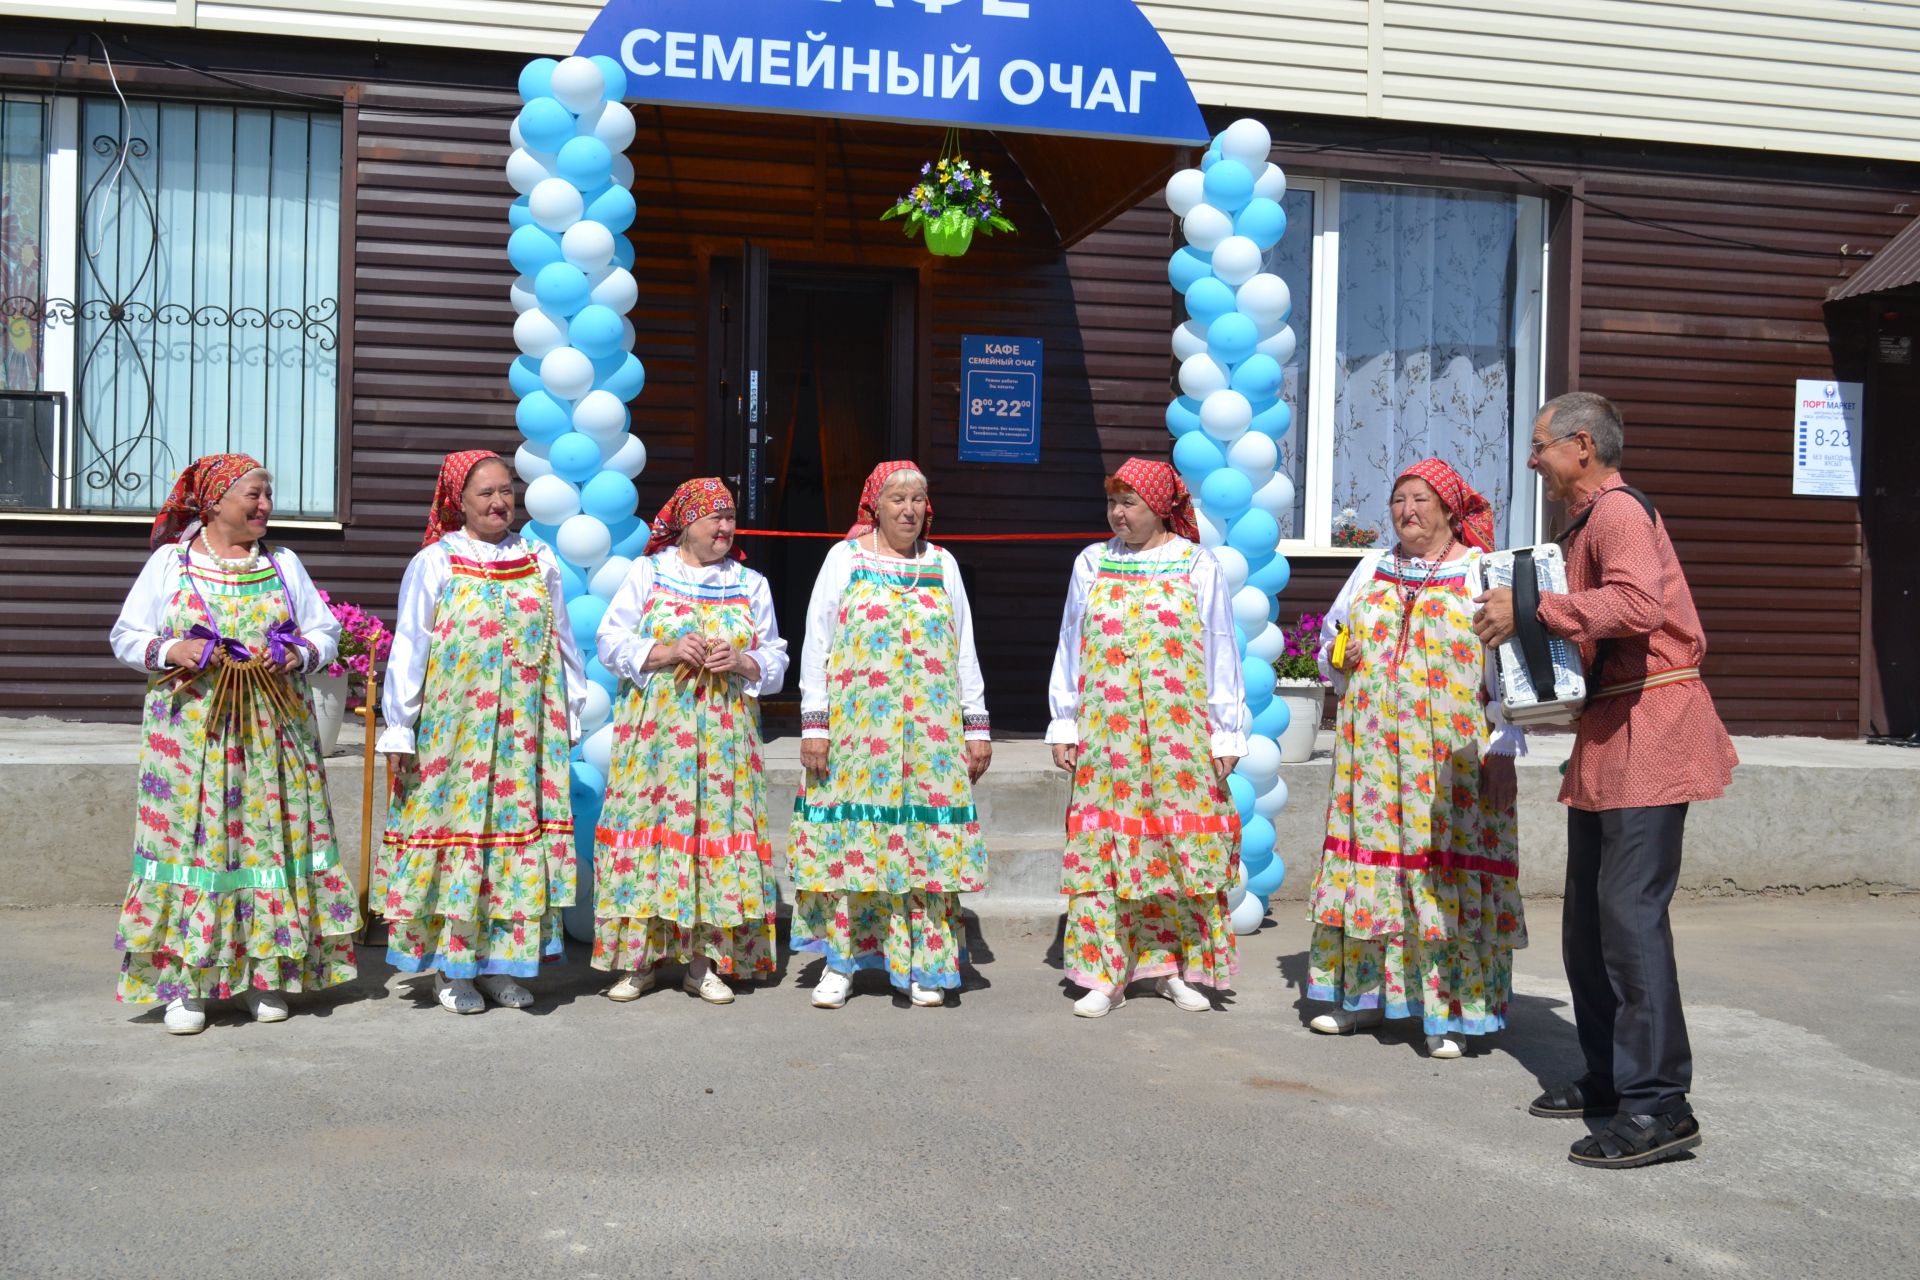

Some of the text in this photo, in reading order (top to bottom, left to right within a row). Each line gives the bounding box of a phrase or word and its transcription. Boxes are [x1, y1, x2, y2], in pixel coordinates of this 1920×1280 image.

[620, 28, 1157, 114] СЕМЕЙНЫЙ ОЧАГ
[985, 344, 1020, 355] КАФЕ
[968, 357, 1036, 367] СЕМЕЙНЫЙ ОЧАГ
[1814, 428, 1852, 447] 8-23
